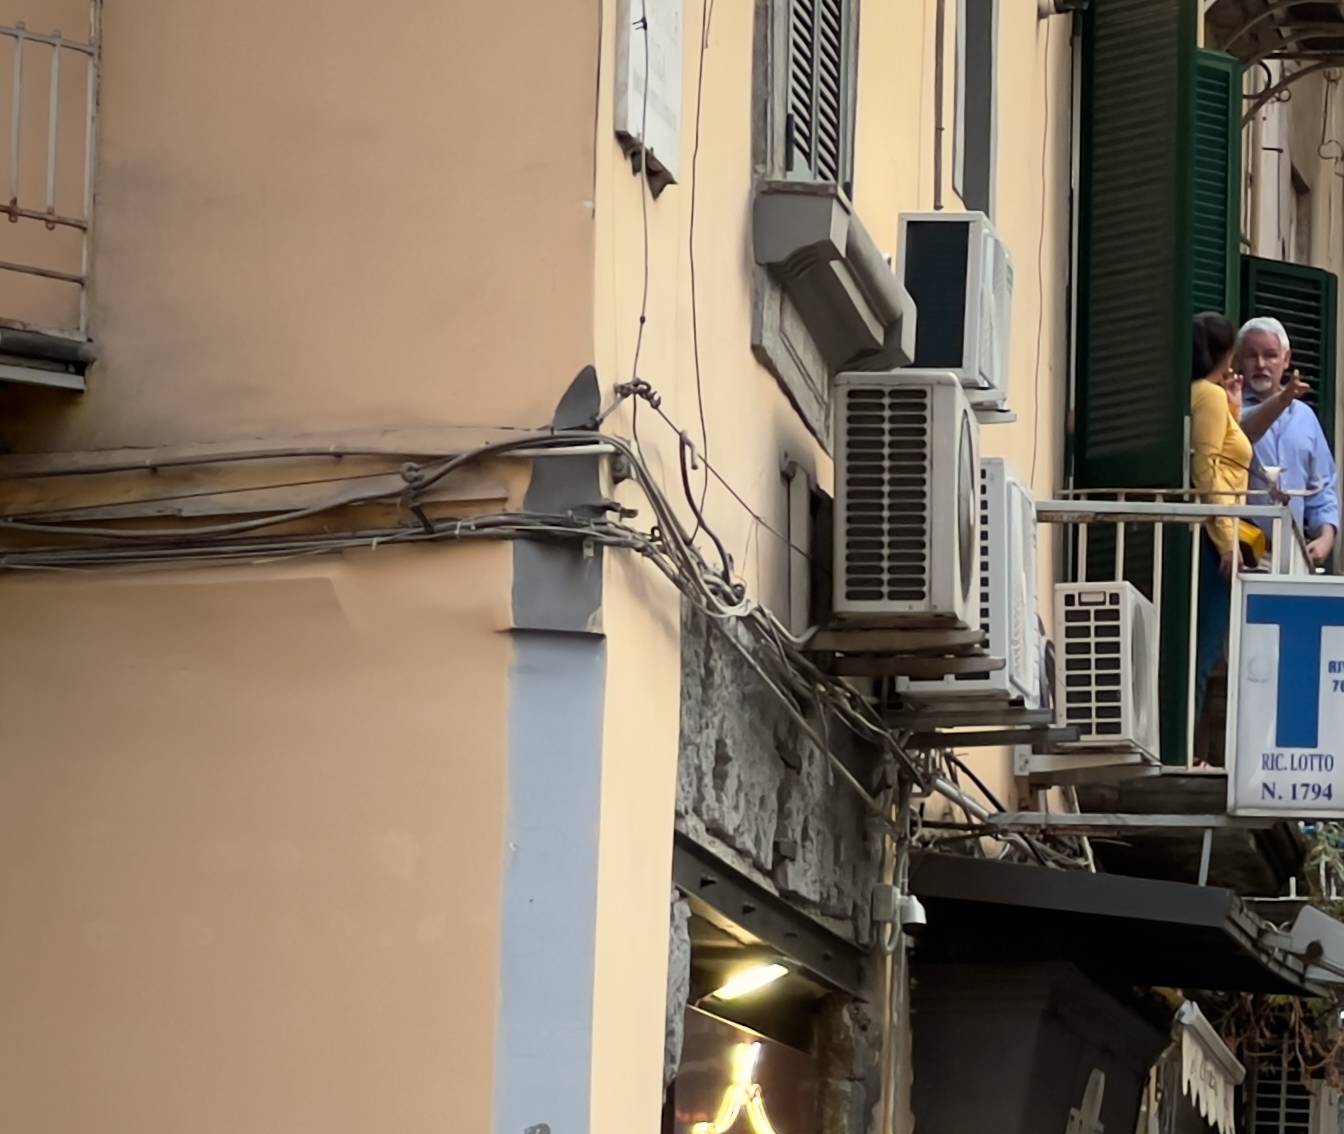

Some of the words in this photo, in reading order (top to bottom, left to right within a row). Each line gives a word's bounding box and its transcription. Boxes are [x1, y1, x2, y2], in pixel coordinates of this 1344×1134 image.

[1261, 753, 1288, 771] RIC.
[1290, 753, 1334, 772] LOTTO
[1261, 782, 1283, 800] N.
[1291, 782, 1333, 801] 1794
